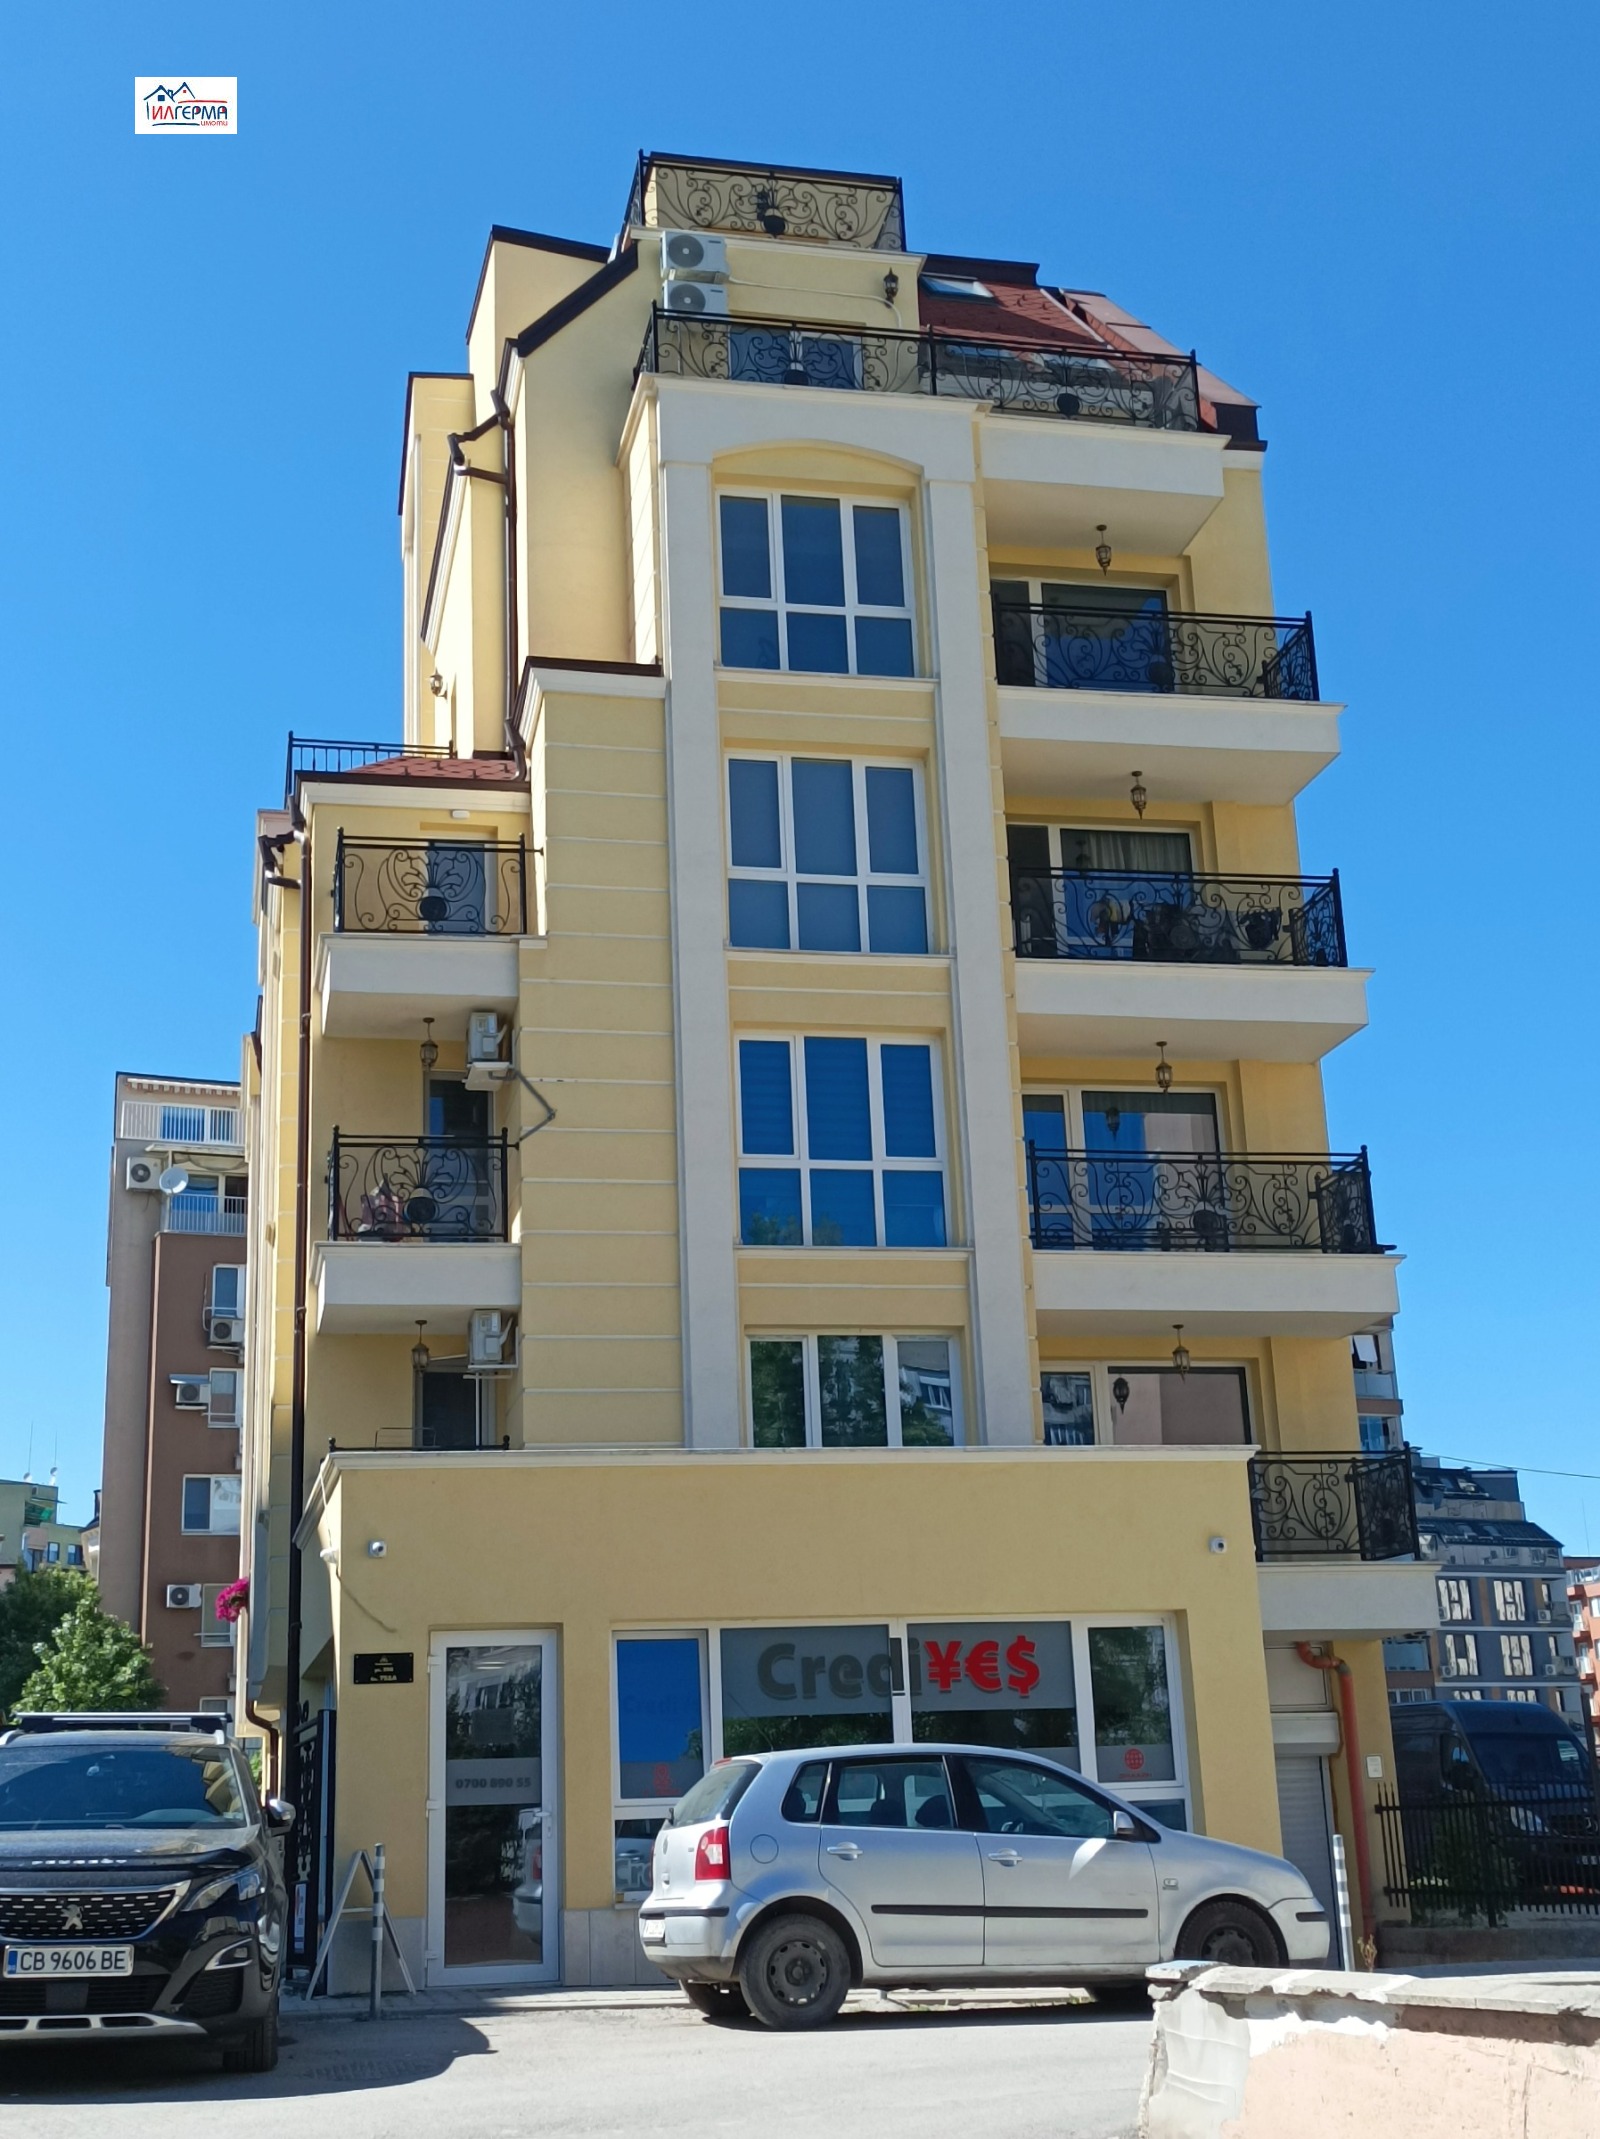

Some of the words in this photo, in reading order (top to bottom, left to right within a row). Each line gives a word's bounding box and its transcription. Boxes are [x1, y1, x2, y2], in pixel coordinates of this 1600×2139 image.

[455, 1778, 487, 1789] 0700
[20, 1951, 45, 1971] CB
[50, 1951, 97, 1971] 9606
[101, 1950, 126, 1970] BE
